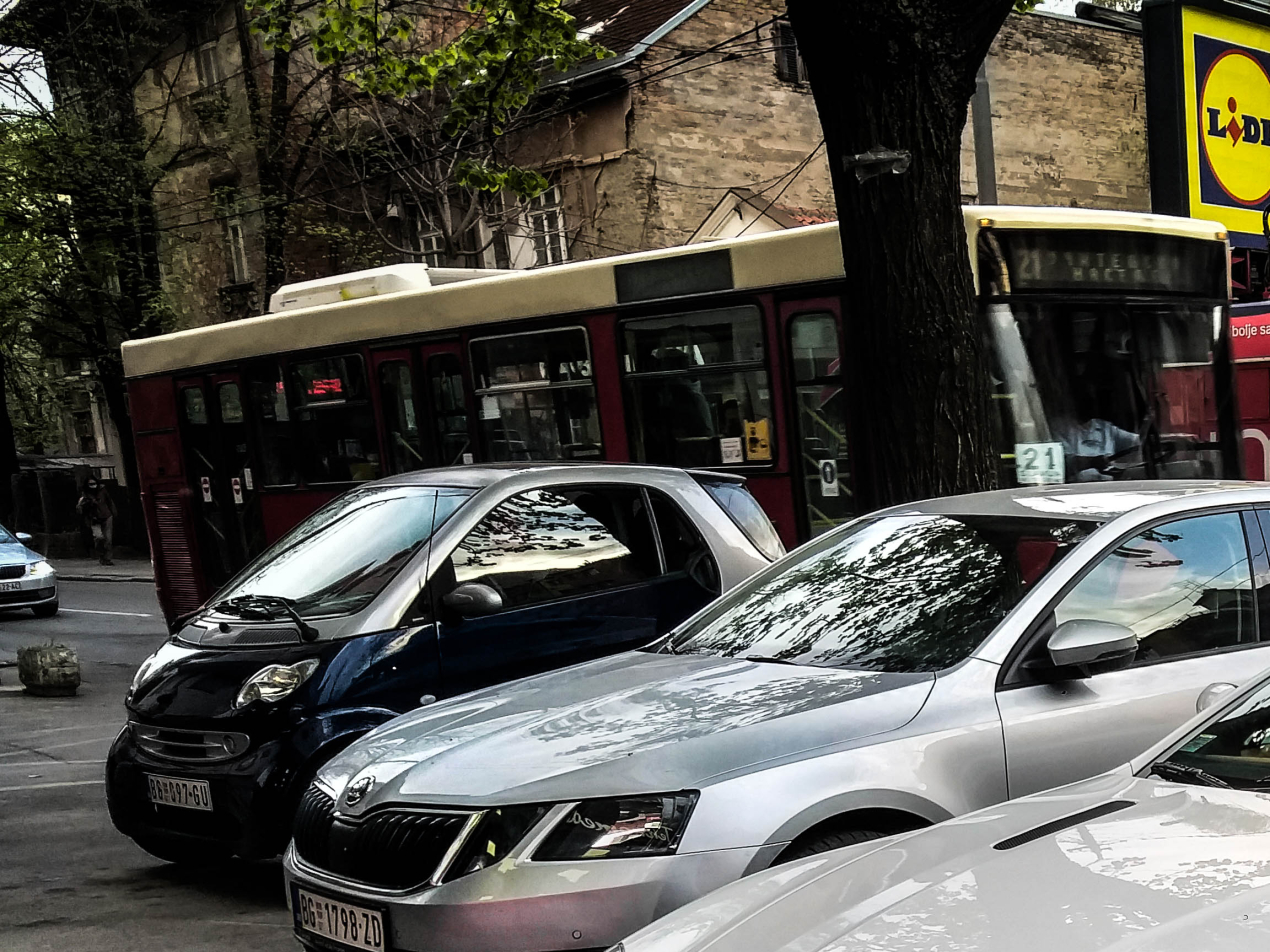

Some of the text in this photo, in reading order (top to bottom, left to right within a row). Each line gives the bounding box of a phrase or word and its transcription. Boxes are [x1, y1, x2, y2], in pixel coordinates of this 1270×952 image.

[1022, 447, 1056, 470] 21
[150, 778, 163, 800] BG
[301, 893, 316, 928] BG
